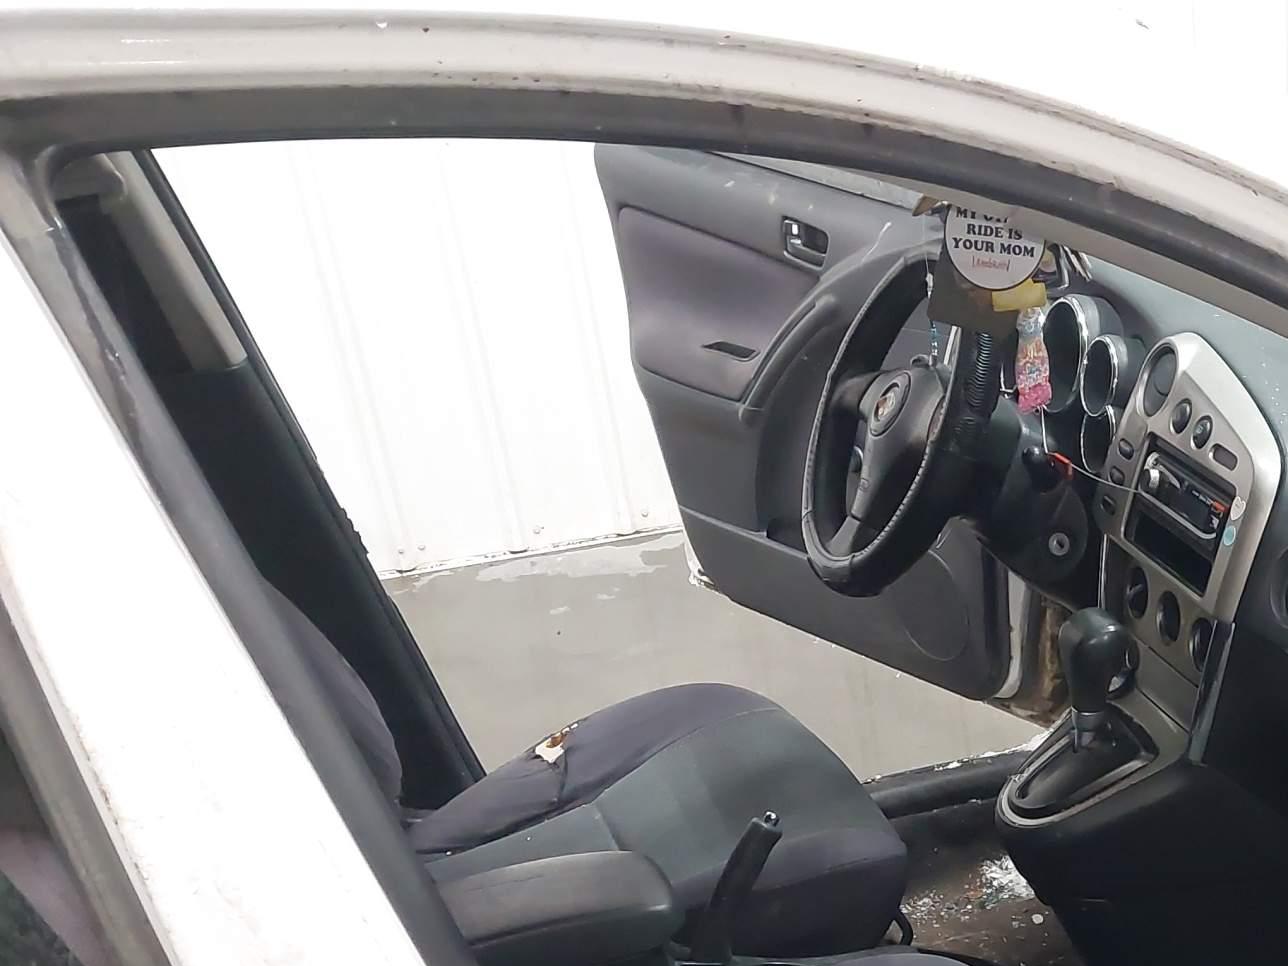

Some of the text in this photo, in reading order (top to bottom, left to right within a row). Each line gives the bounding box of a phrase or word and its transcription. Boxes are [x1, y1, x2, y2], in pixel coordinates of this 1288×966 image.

[966, 223, 1023, 241] RIDE IS
[952, 237, 1036, 258] YOUR MOM
